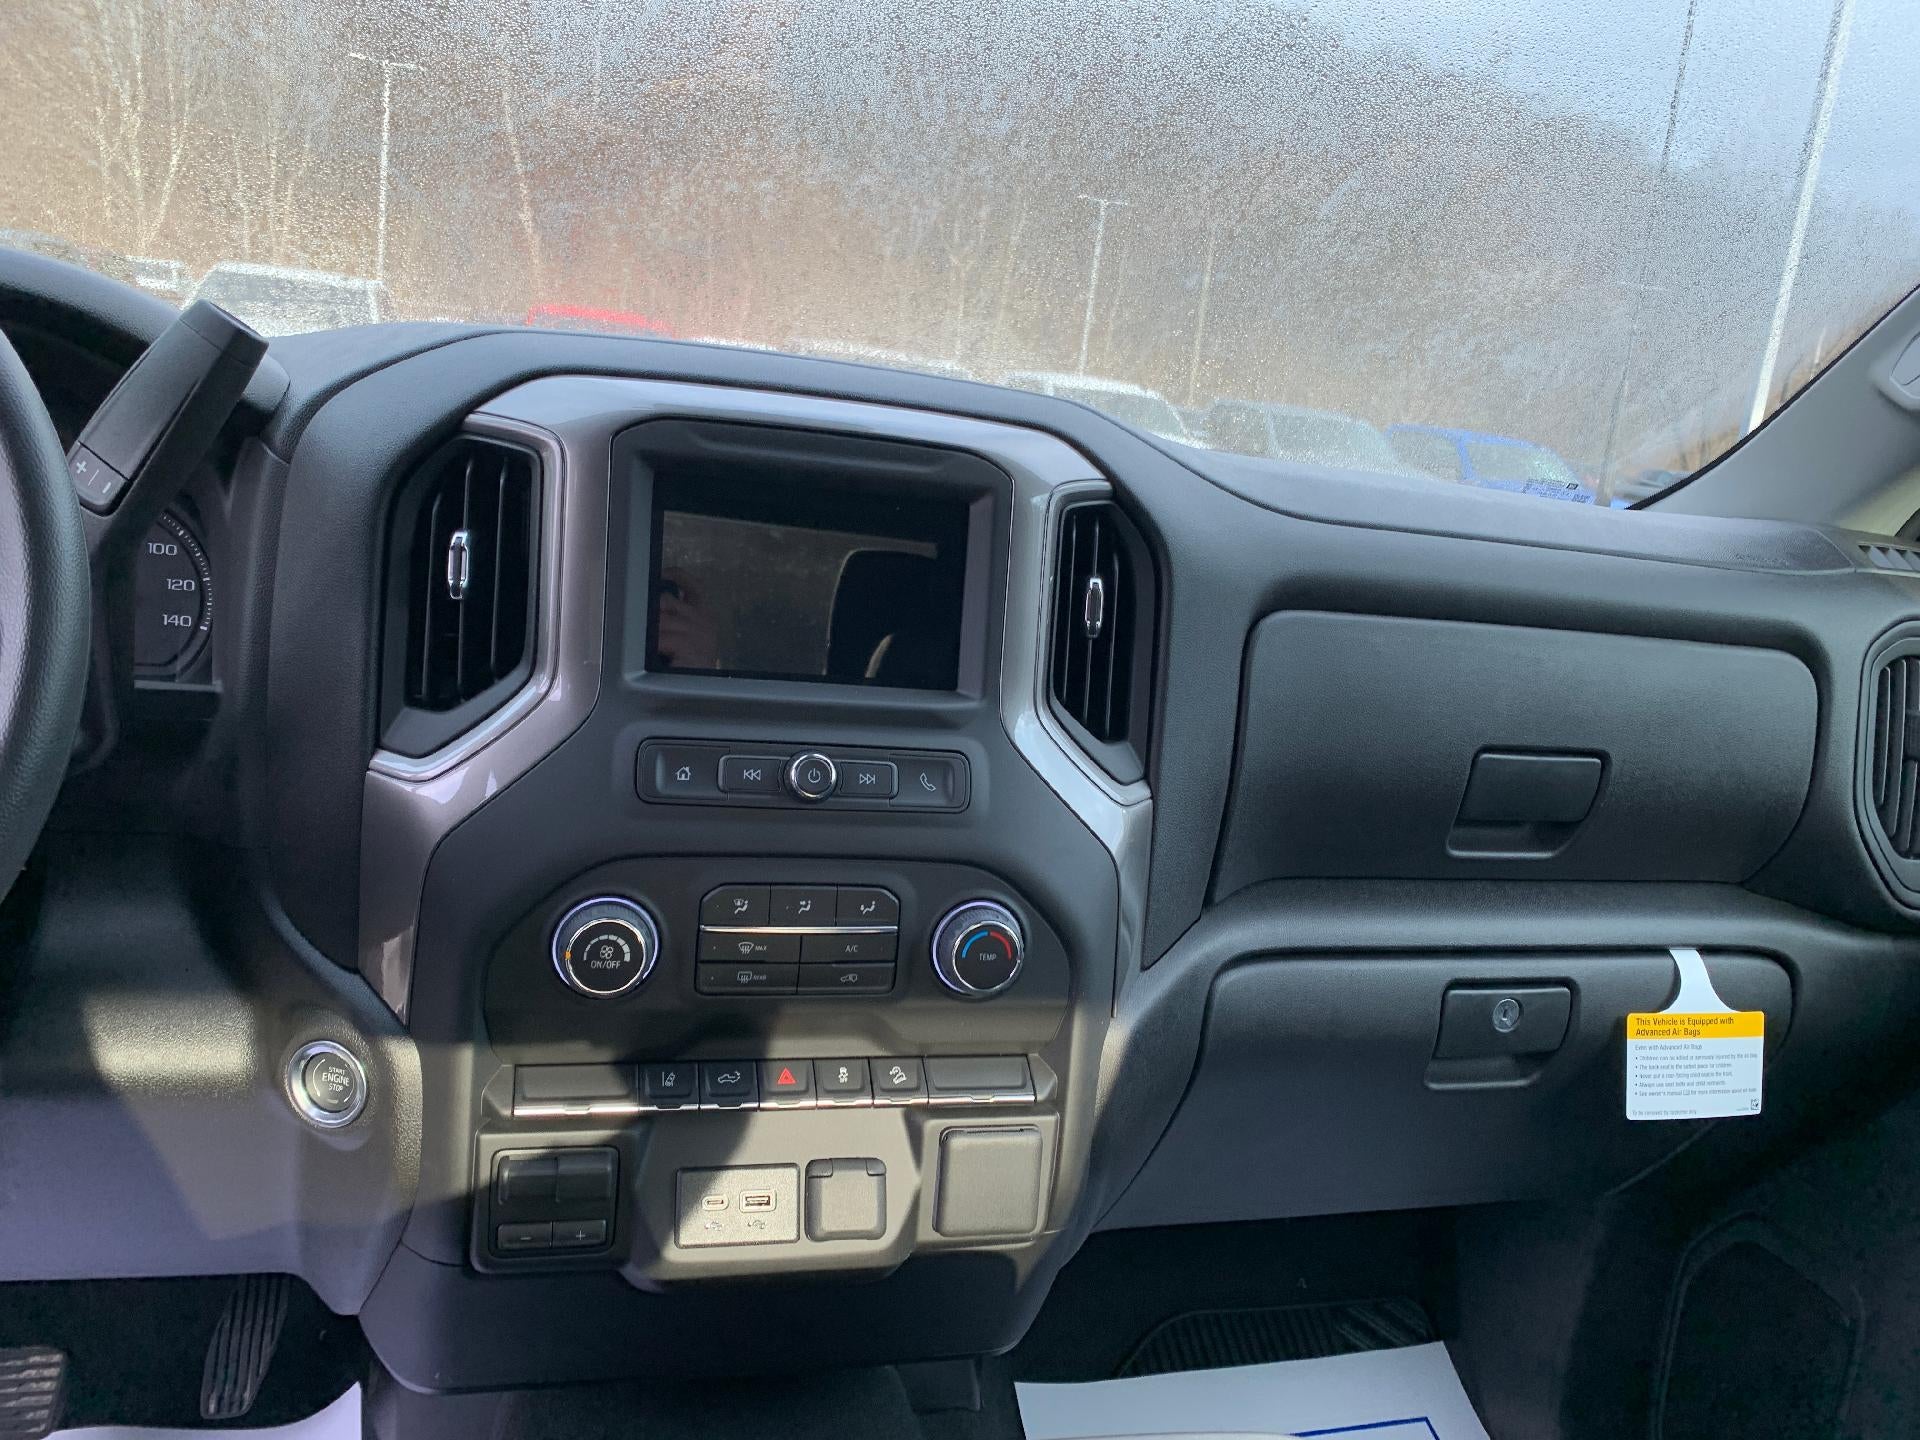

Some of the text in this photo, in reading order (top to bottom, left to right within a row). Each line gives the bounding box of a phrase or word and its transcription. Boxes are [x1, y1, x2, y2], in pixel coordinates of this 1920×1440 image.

[147, 542, 178, 556] 100
[166, 578, 195, 592] 120
[162, 613, 192, 627] 140
[844, 944, 859, 953] A/C
[979, 952, 997, 961] TEMP
[590, 960, 621, 969] ON/OFF
[1635, 1016, 1735, 1027] This Vehicle is Equipped with
[1635, 1027, 1701, 1038] Advanced Air Bags
[321, 1072, 350, 1087] ENGINE
[328, 1083, 344, 1092] STOP
